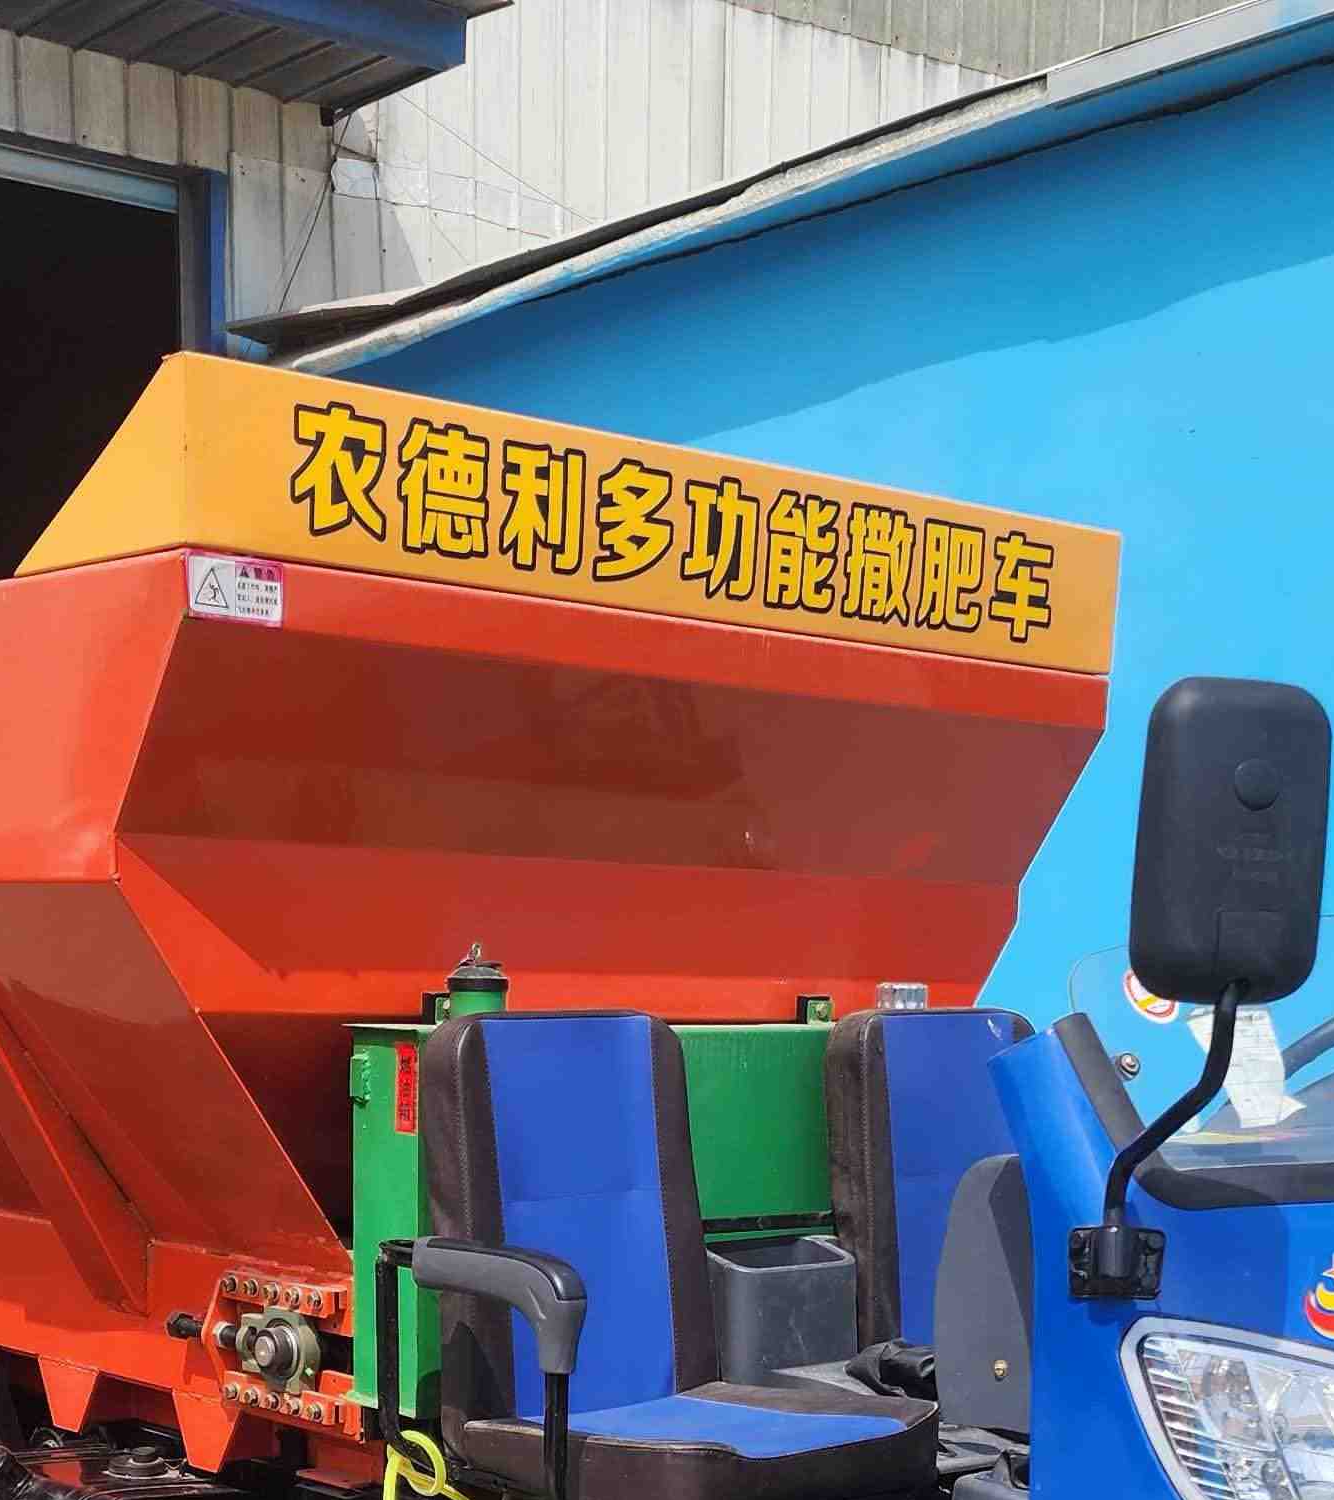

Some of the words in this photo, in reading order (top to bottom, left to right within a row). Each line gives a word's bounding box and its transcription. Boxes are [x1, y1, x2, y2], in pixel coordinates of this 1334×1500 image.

[291, 401, 1056, 643] 农德利多功能撒肥车
